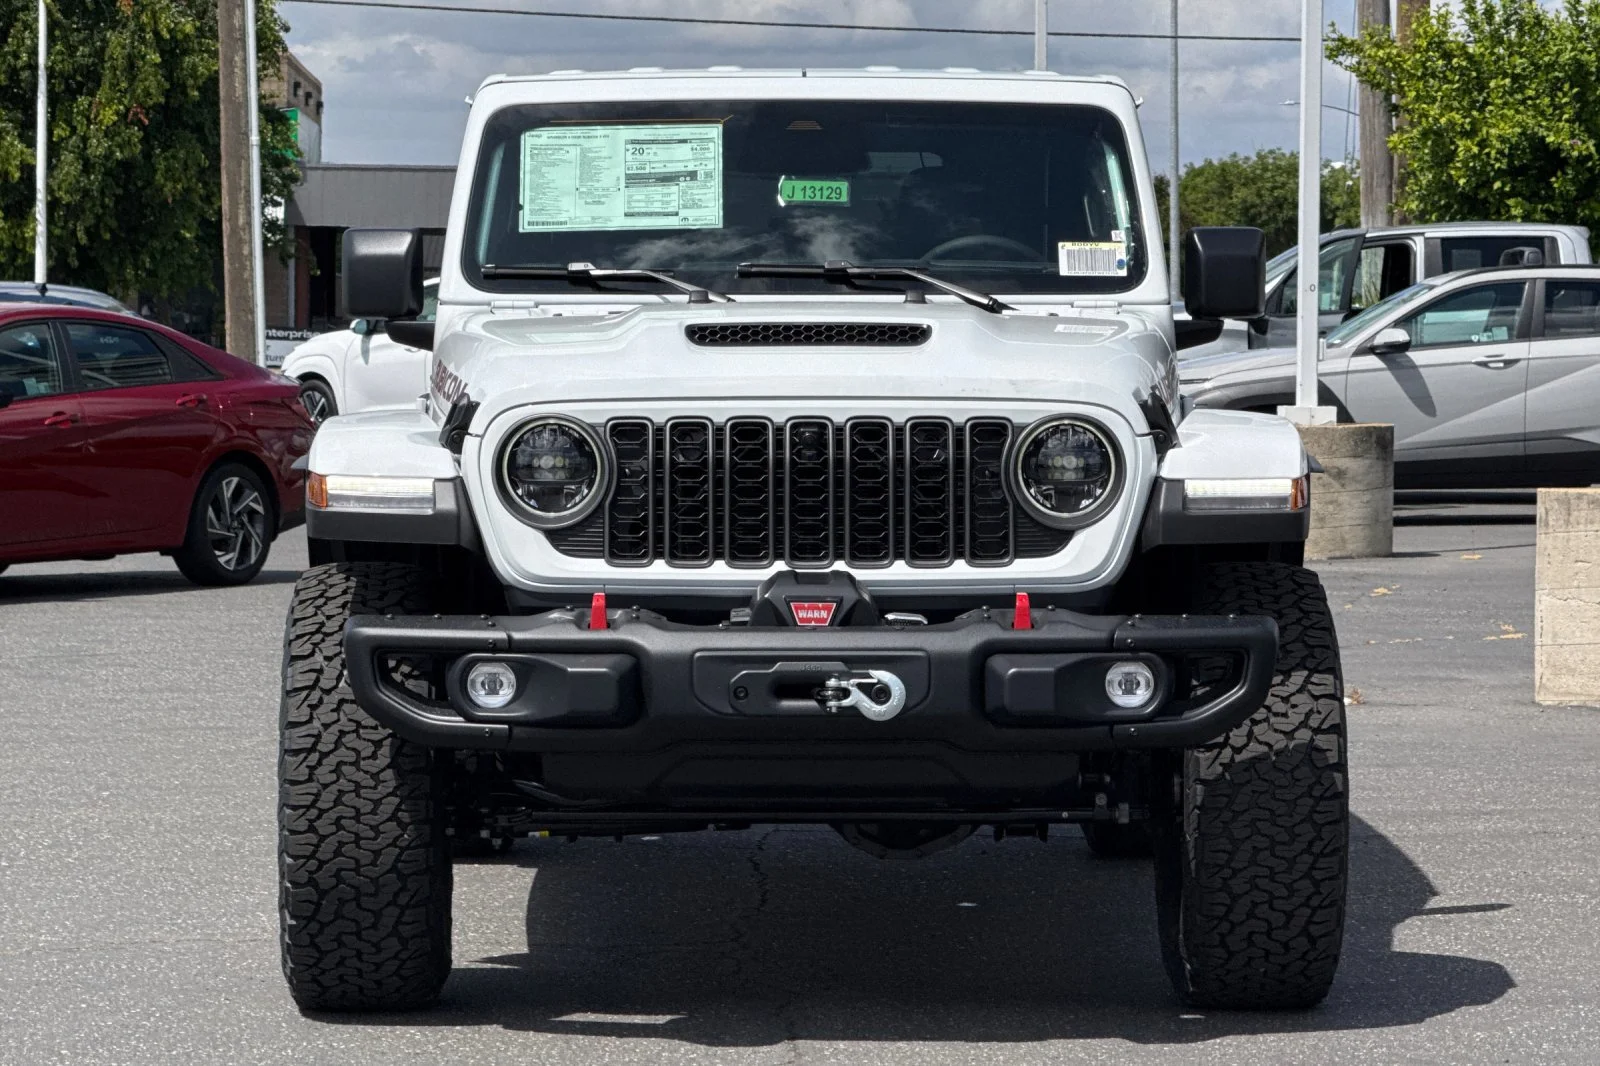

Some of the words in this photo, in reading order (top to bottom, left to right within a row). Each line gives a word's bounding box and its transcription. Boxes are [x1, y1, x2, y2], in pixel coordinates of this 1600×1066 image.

[631, 147, 645, 156] 20
[787, 185, 796, 199] J
[801, 185, 843, 200] 13129
[265, 328, 320, 340] nterprise
[798, 609, 828, 619] WARN
